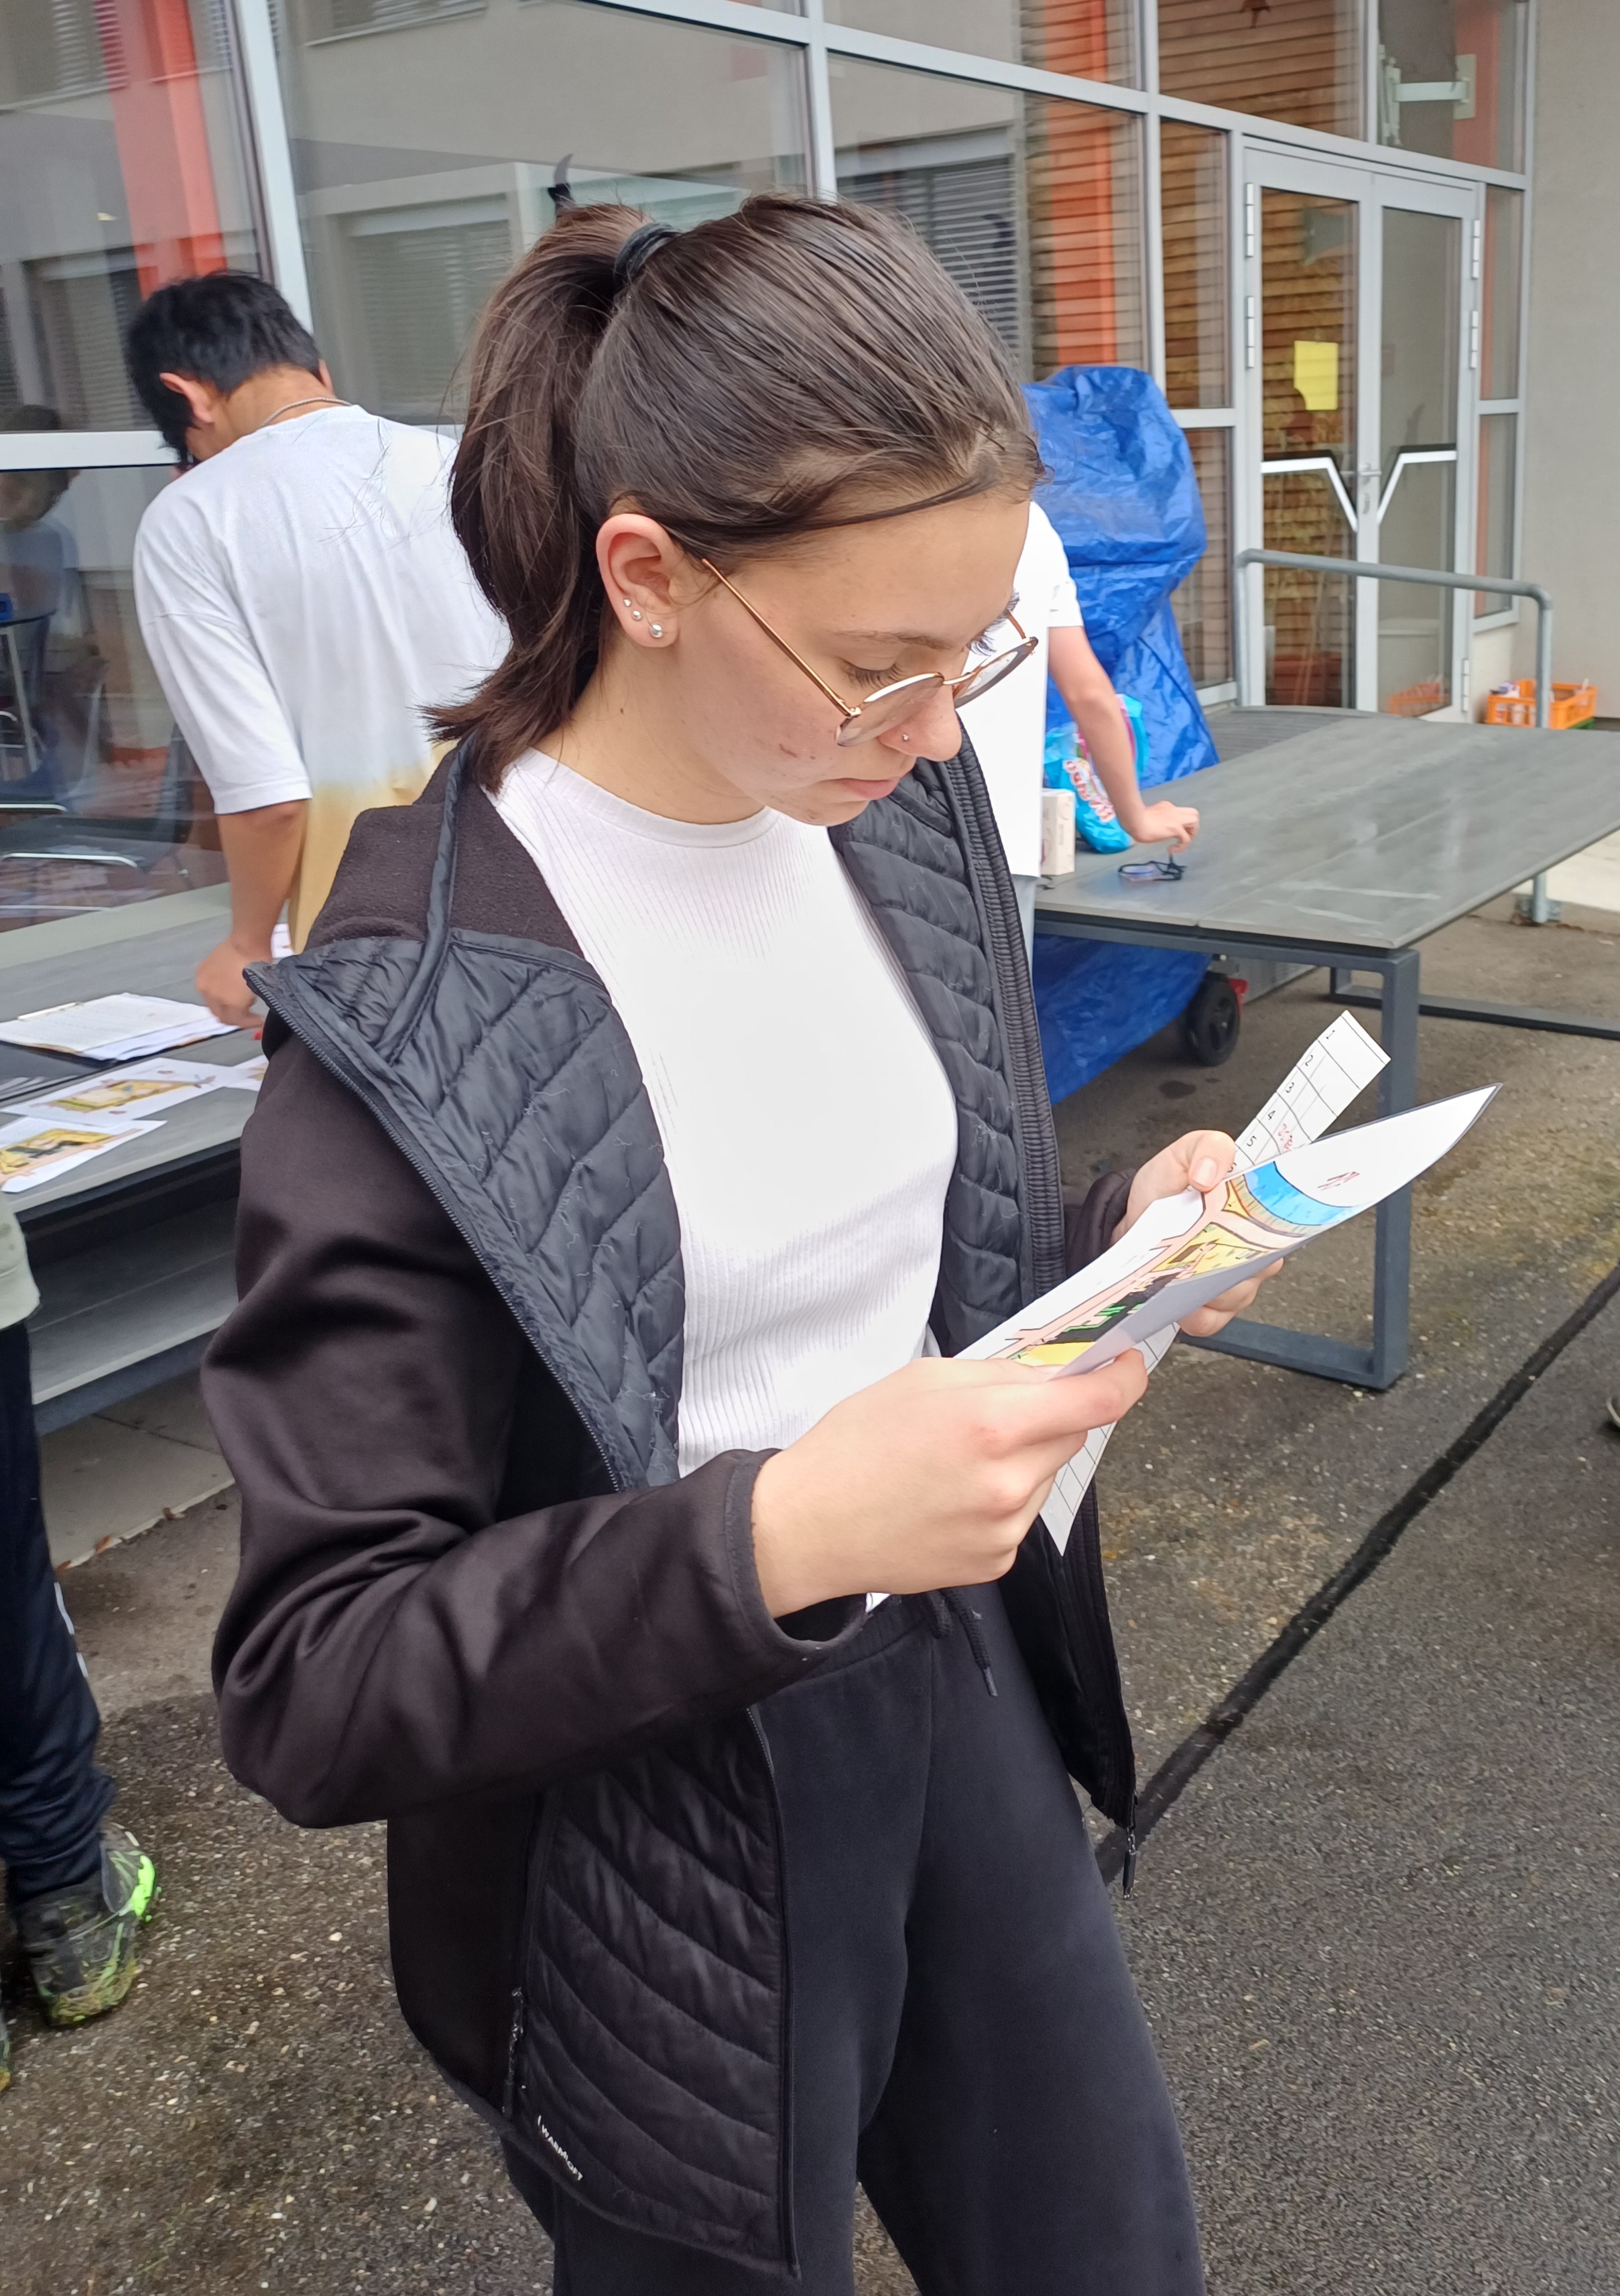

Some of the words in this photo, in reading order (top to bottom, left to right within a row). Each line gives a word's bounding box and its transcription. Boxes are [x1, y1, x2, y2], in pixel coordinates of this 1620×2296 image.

[1304, 1054, 1314, 1067] 2
[1286, 1082, 1294, 1093] 3
[1267, 1110, 1276, 1121] 4
[1246, 1135, 1257, 1147] 5
